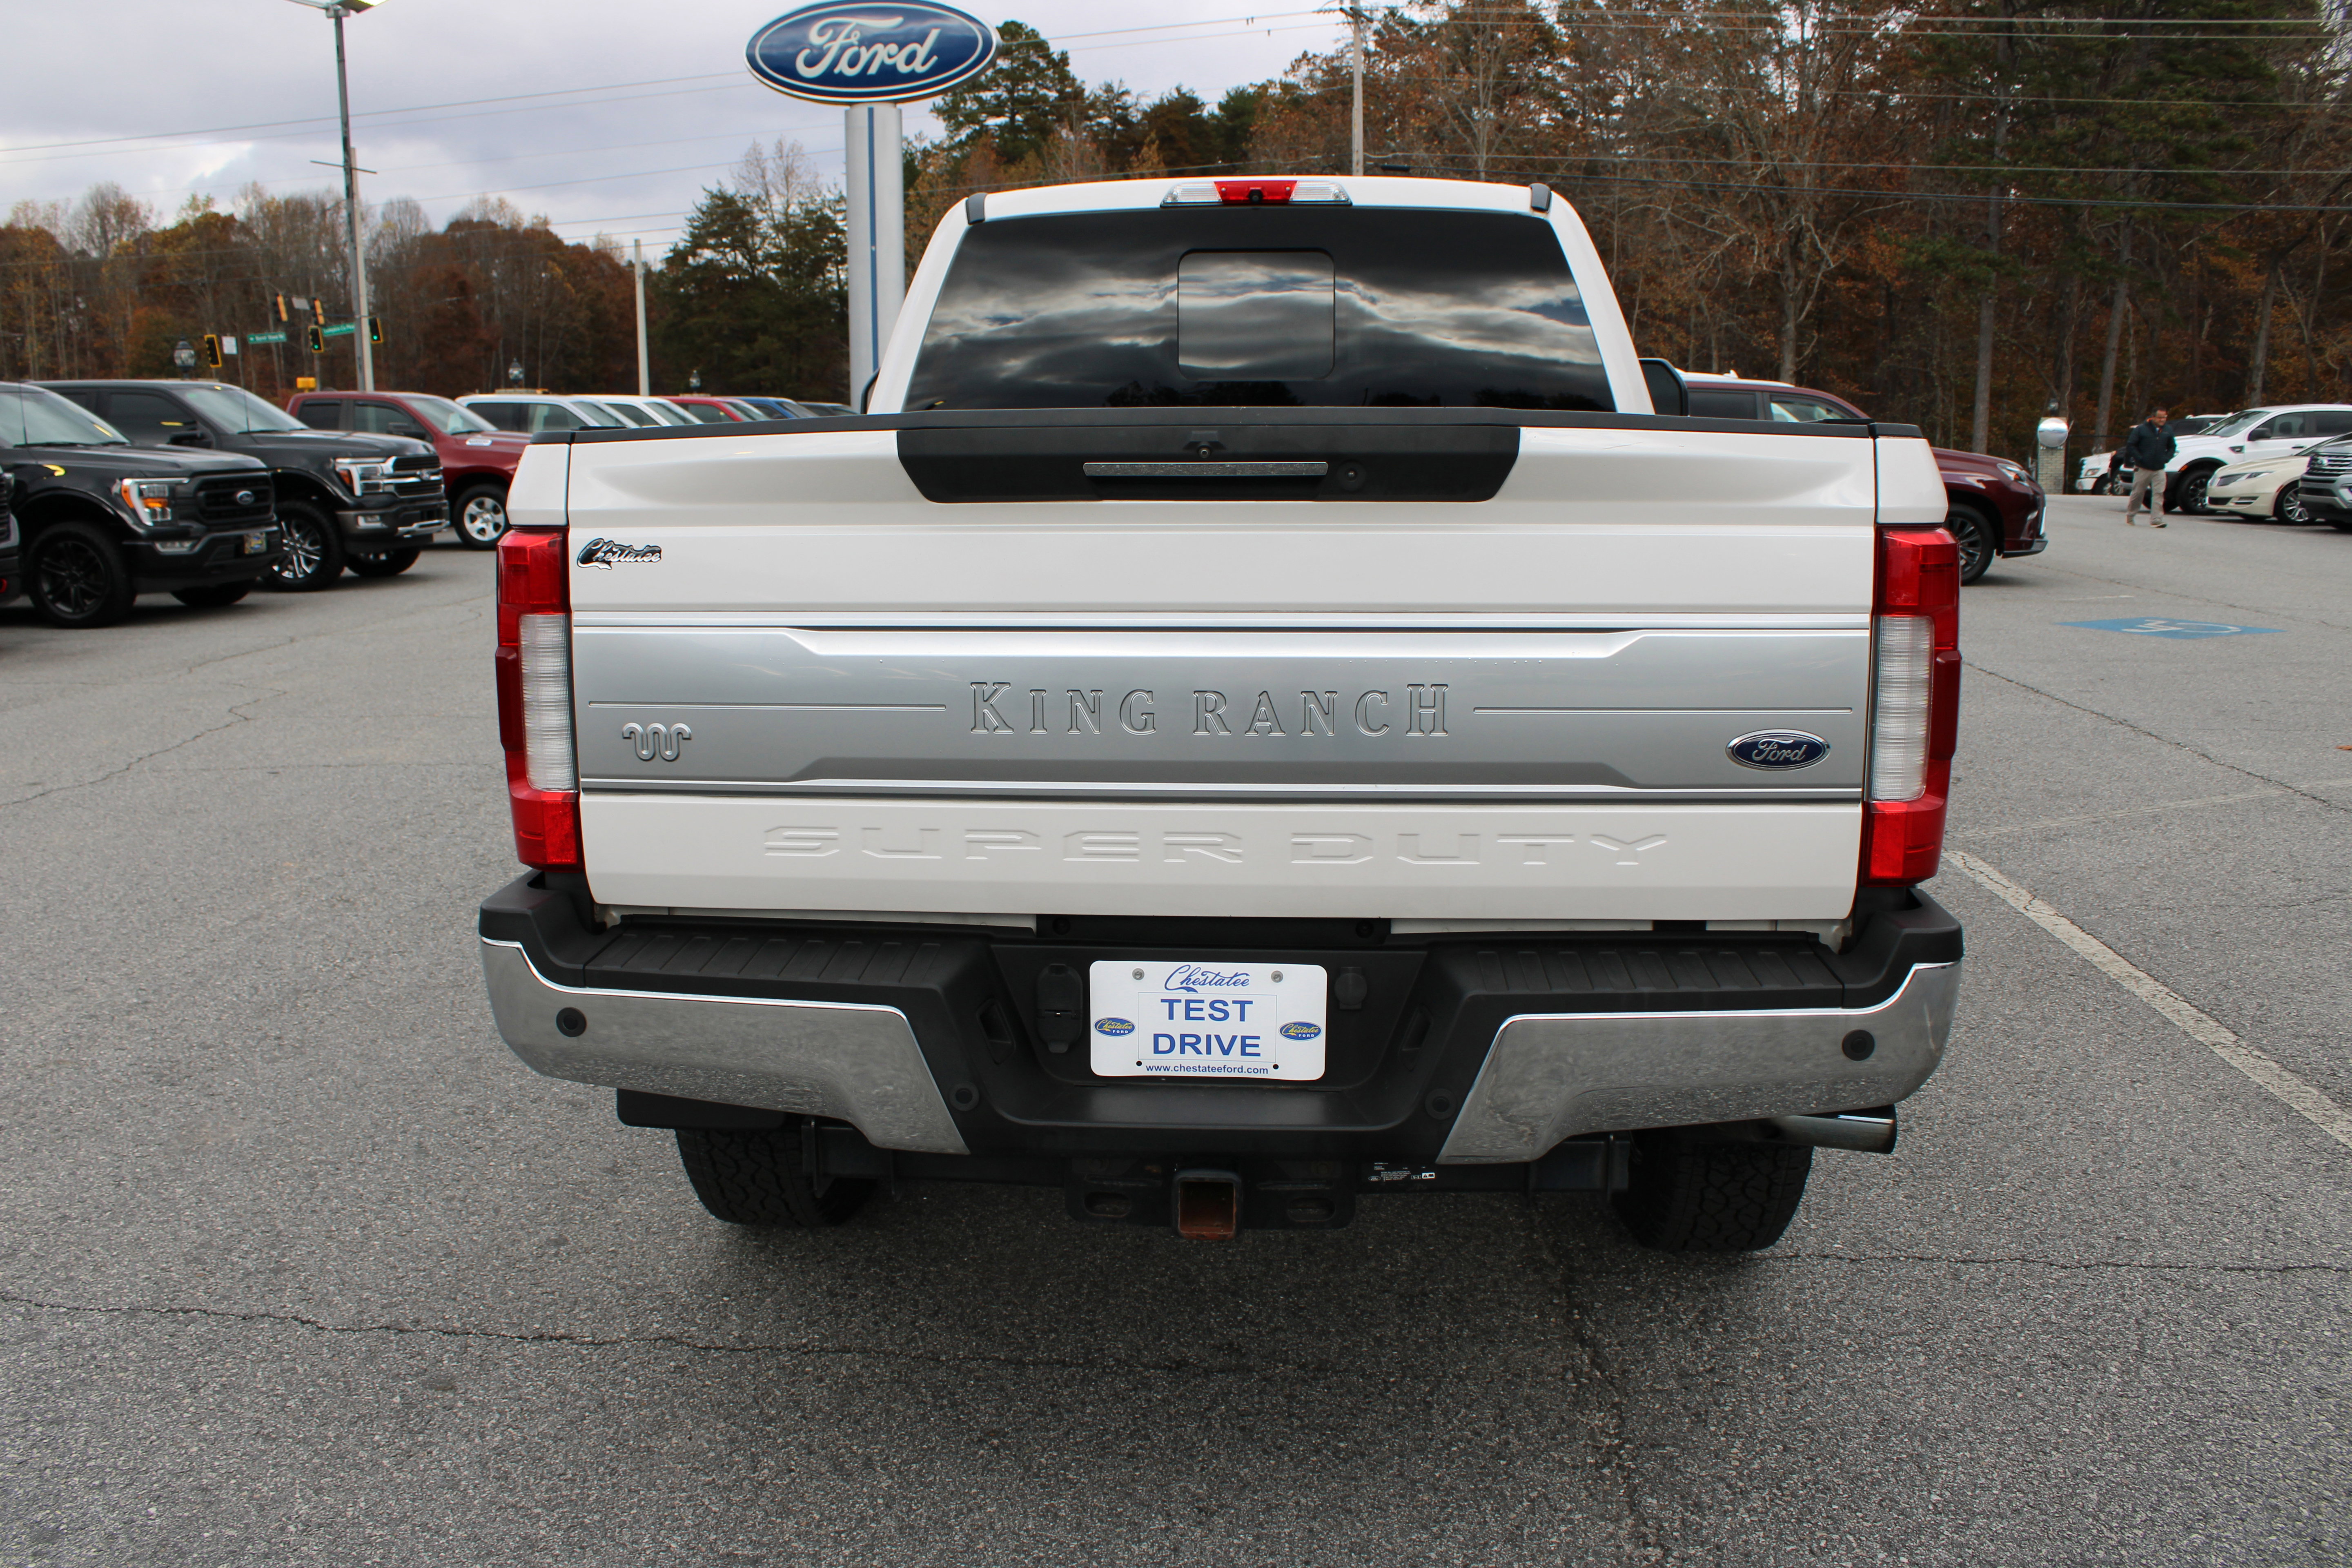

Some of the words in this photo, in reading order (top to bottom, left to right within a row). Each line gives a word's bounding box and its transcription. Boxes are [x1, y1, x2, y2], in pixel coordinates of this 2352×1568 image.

[795, 16, 941, 78] Ford
[970, 682, 1156, 734] KING
[1193, 684, 1448, 736] RANCH
[1752, 738, 1808, 761] Ford
[764, 826, 1243, 862] SUPER
[1292, 832, 1667, 866] DUTY
[1164, 964, 1250, 993] Chestatee
[1160, 998, 1253, 1022] TEST
[1096, 1019, 1132, 1031] Chestatee
[1282, 1023, 1319, 1036] Chestatee
[1153, 1033, 1261, 1057] DRIVE
[1146, 1063, 1269, 1075] www.chestateeford.com
